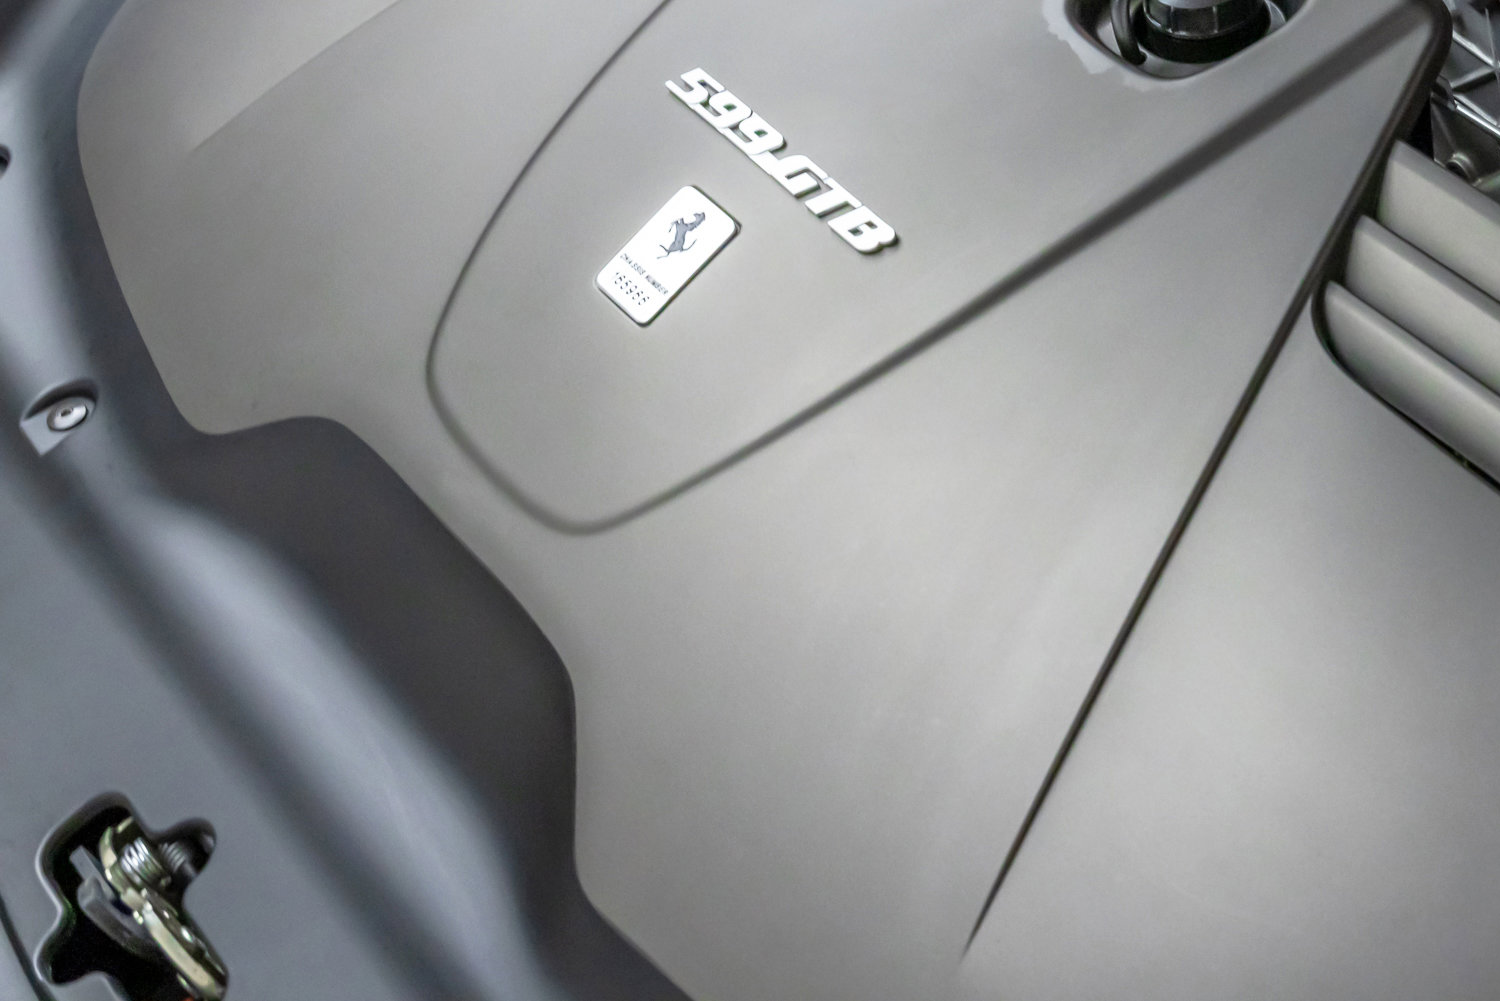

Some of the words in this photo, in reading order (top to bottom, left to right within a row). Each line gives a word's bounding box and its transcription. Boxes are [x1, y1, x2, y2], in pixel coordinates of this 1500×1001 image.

[665, 67, 787, 156] 599
[769, 154, 898, 256] GTB
[645, 274, 669, 296] NUMBER
